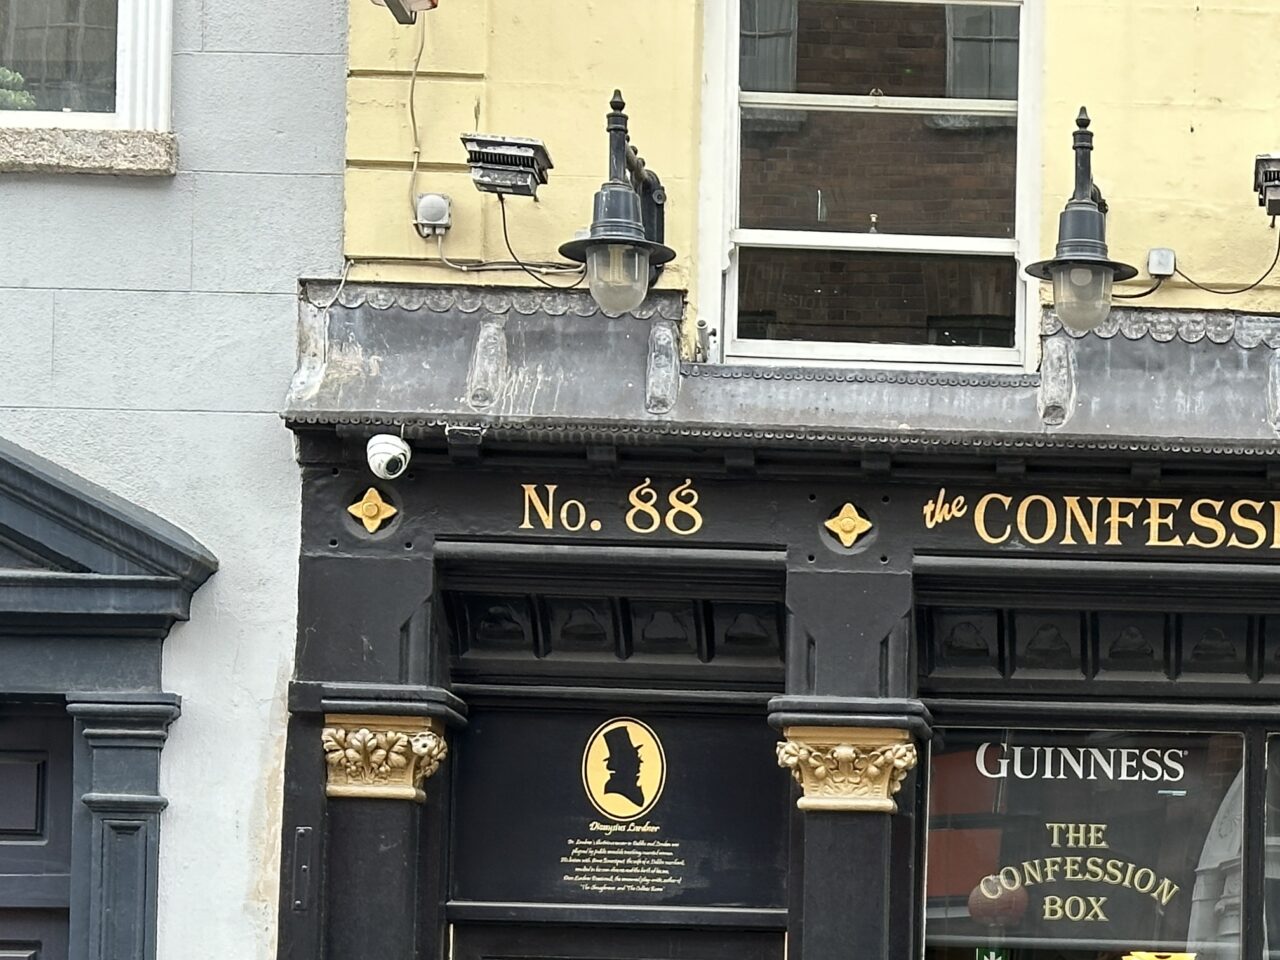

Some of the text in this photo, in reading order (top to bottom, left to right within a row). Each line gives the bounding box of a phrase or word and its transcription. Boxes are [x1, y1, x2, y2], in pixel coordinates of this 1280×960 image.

[518, 477, 703, 535] No. 88
[923, 488, 968, 528] the
[975, 742, 1185, 782] GUINNESS
[1046, 823, 1109, 849] THE
[980, 856, 1180, 906] CONFESSION
[1043, 895, 1109, 922] BOX
